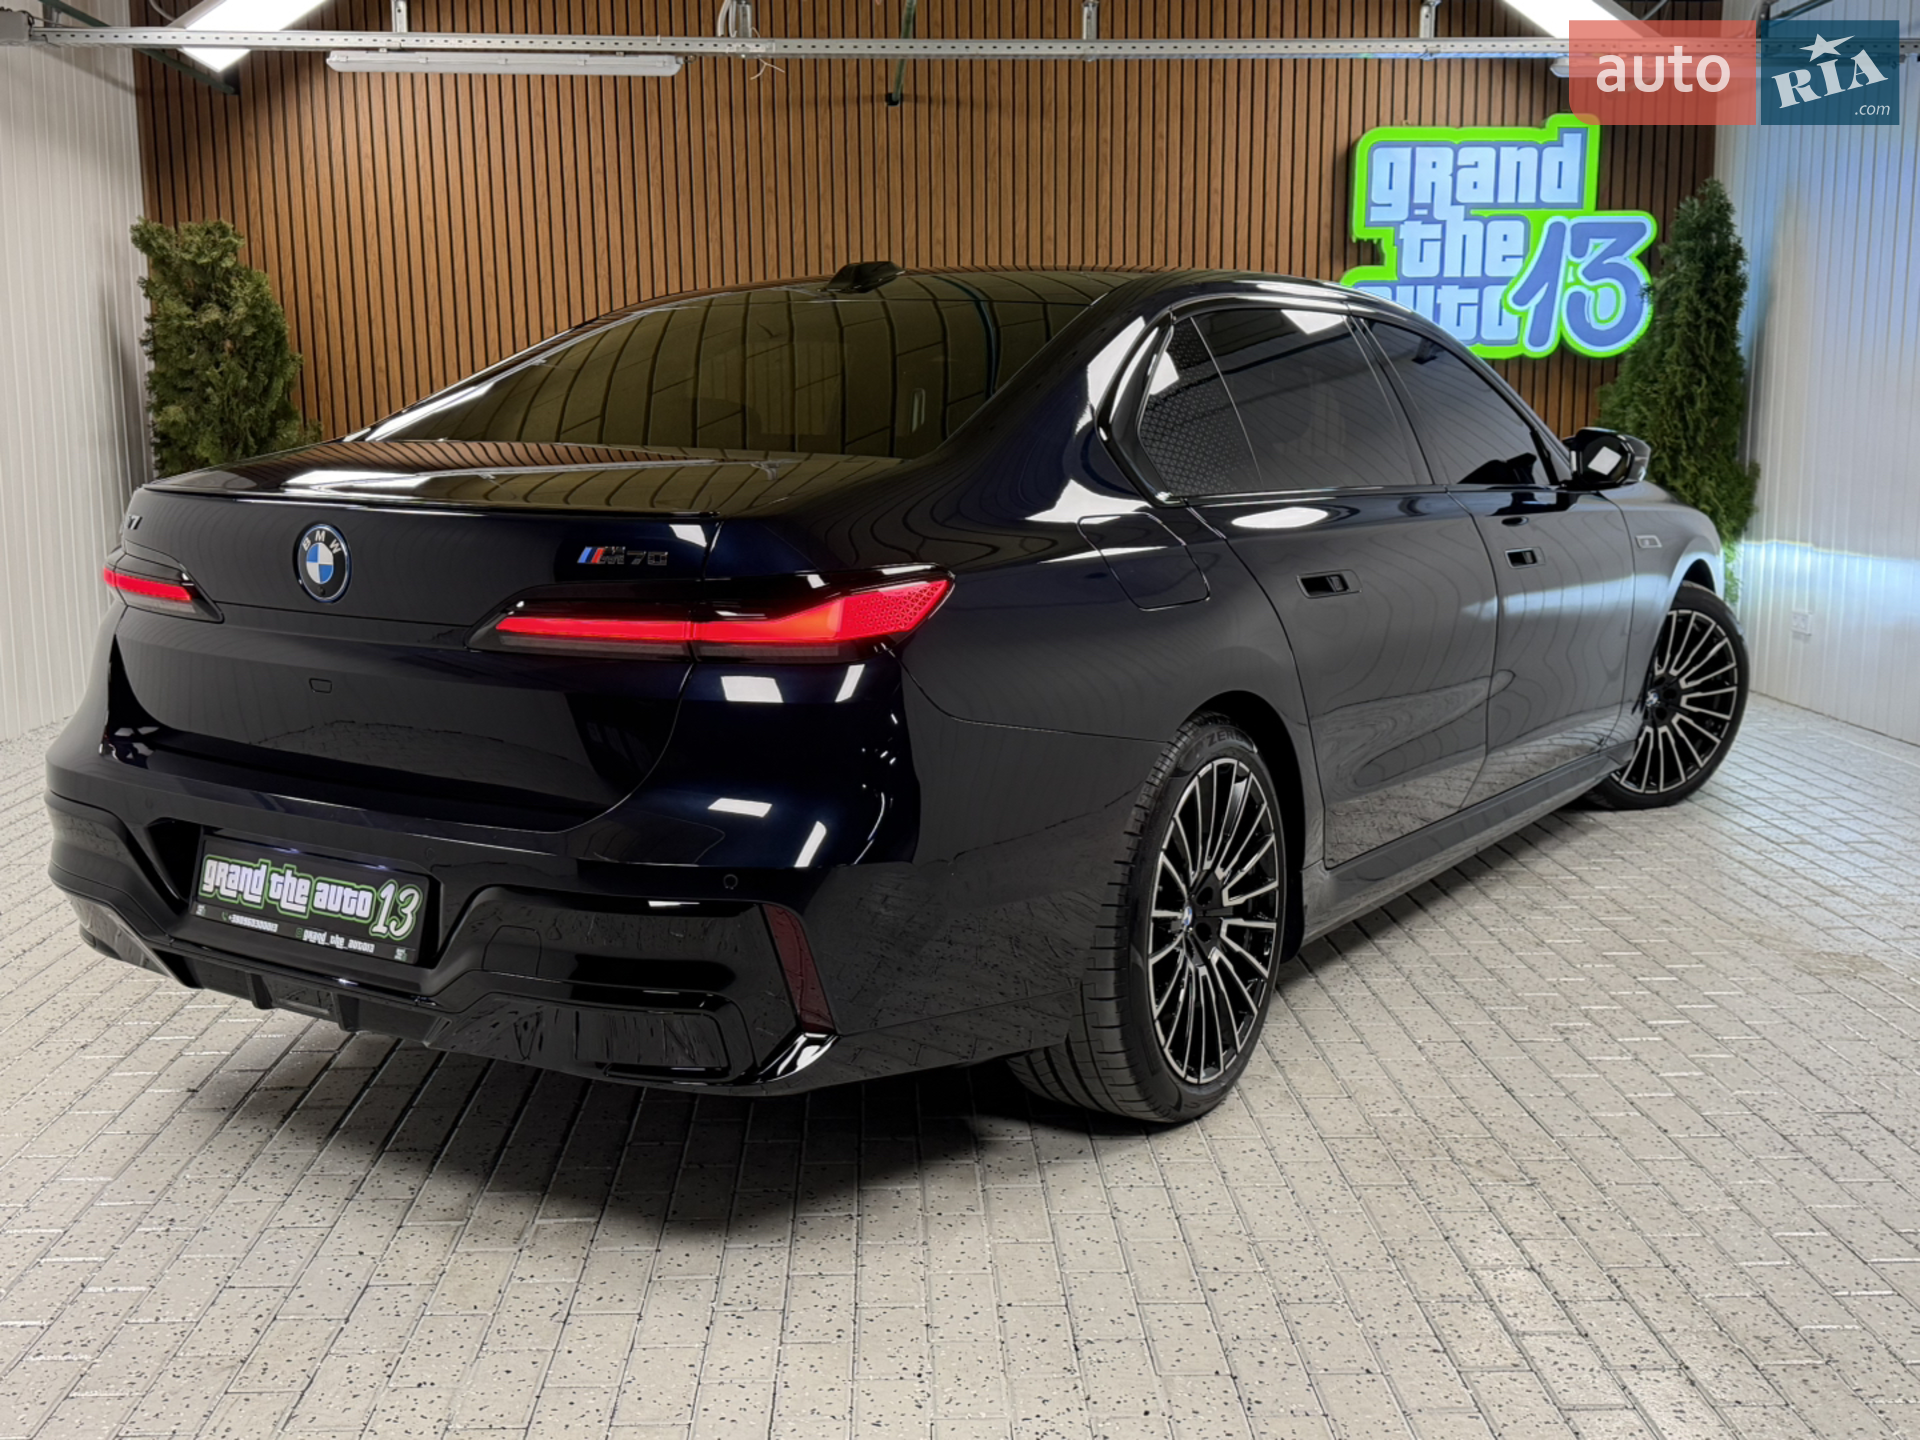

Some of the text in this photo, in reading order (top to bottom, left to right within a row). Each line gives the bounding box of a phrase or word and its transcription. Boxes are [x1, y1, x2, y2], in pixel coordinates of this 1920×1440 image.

[1399, 205, 1525, 277] the
[1508, 215, 1652, 350] 13
[302, 530, 342, 554] BMW
[268, 868, 311, 913] the
[313, 882, 373, 919] auto
[372, 883, 420, 937] 13
